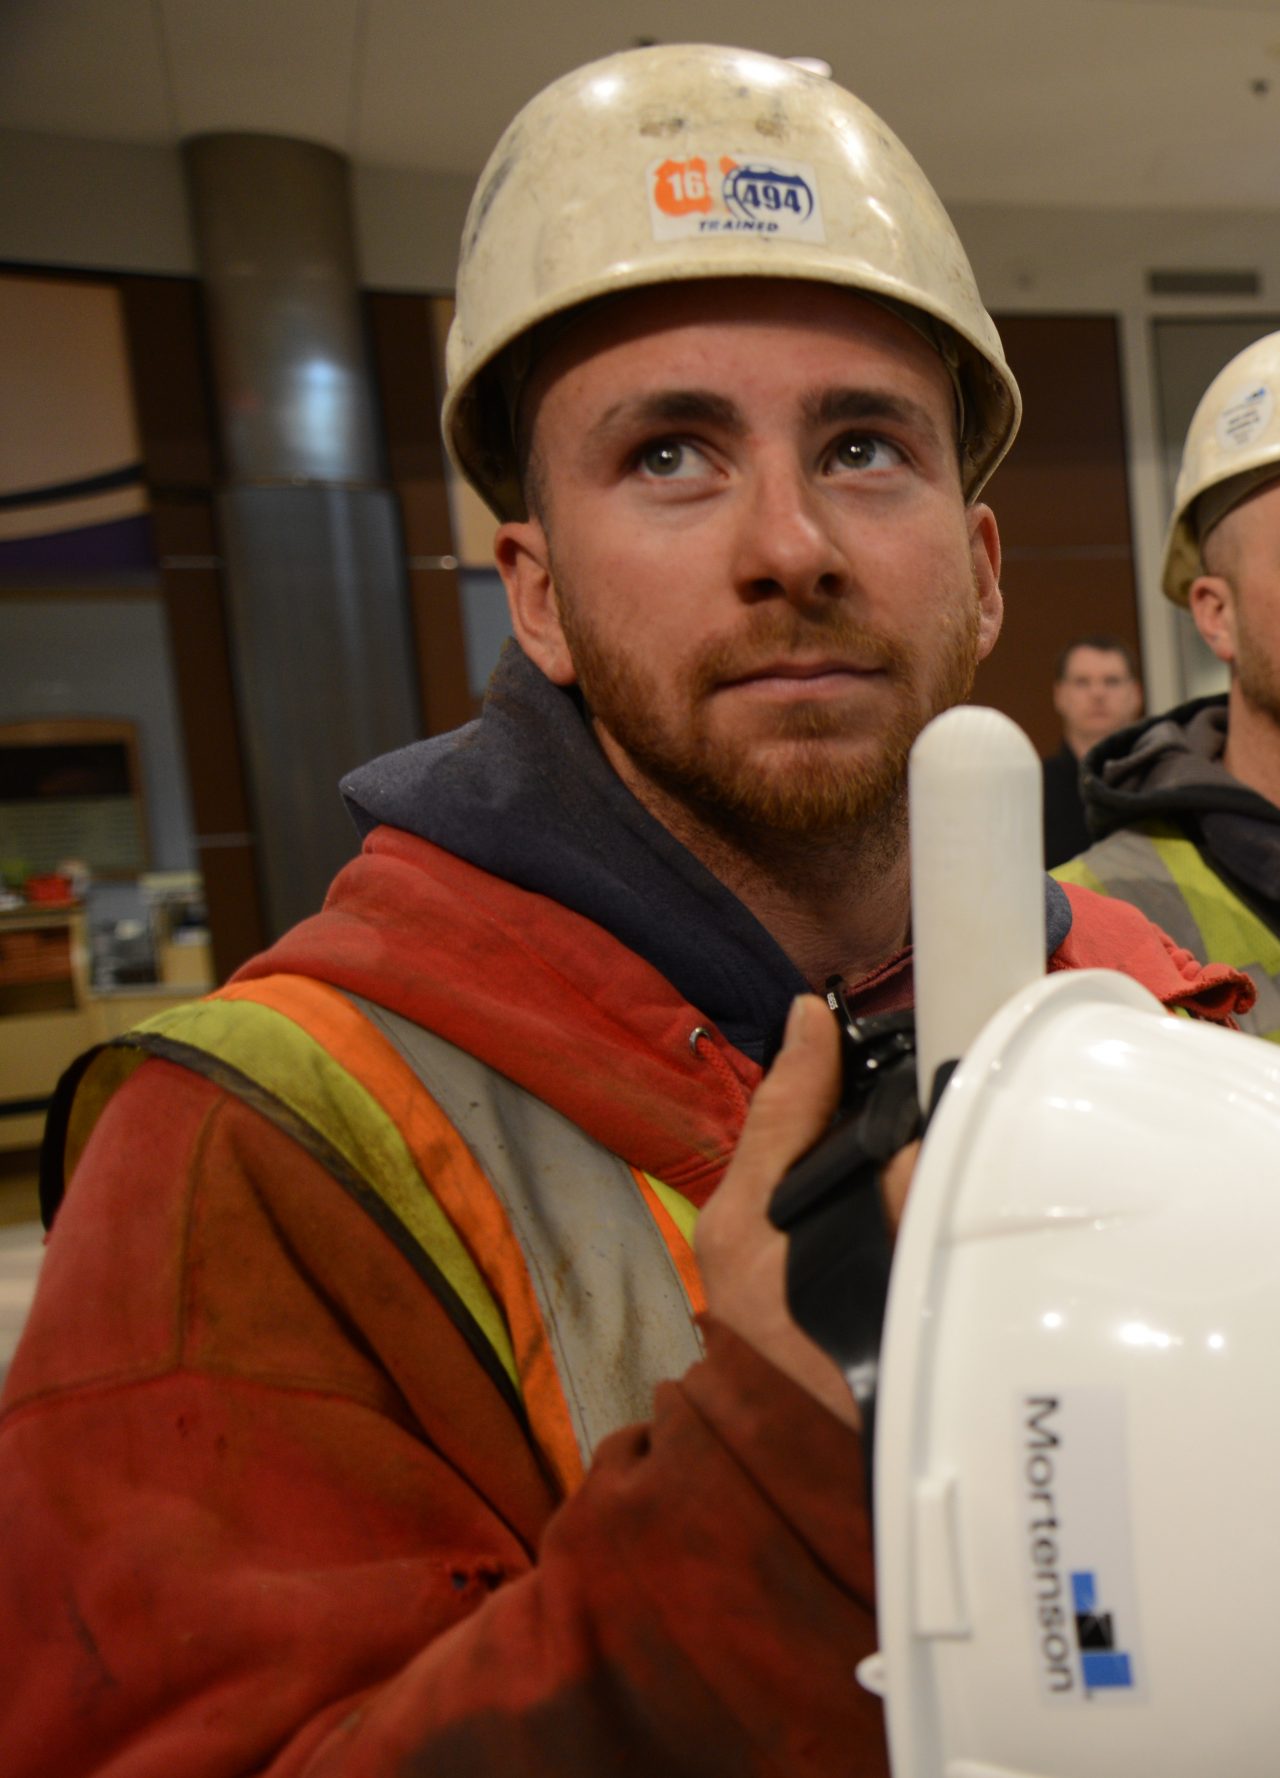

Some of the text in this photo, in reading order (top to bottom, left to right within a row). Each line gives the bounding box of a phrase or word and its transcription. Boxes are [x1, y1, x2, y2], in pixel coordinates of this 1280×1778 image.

[742, 183, 802, 214] 494
[699, 219, 779, 234] TRAINED
[1025, 1396, 1074, 1693] Mortenson
